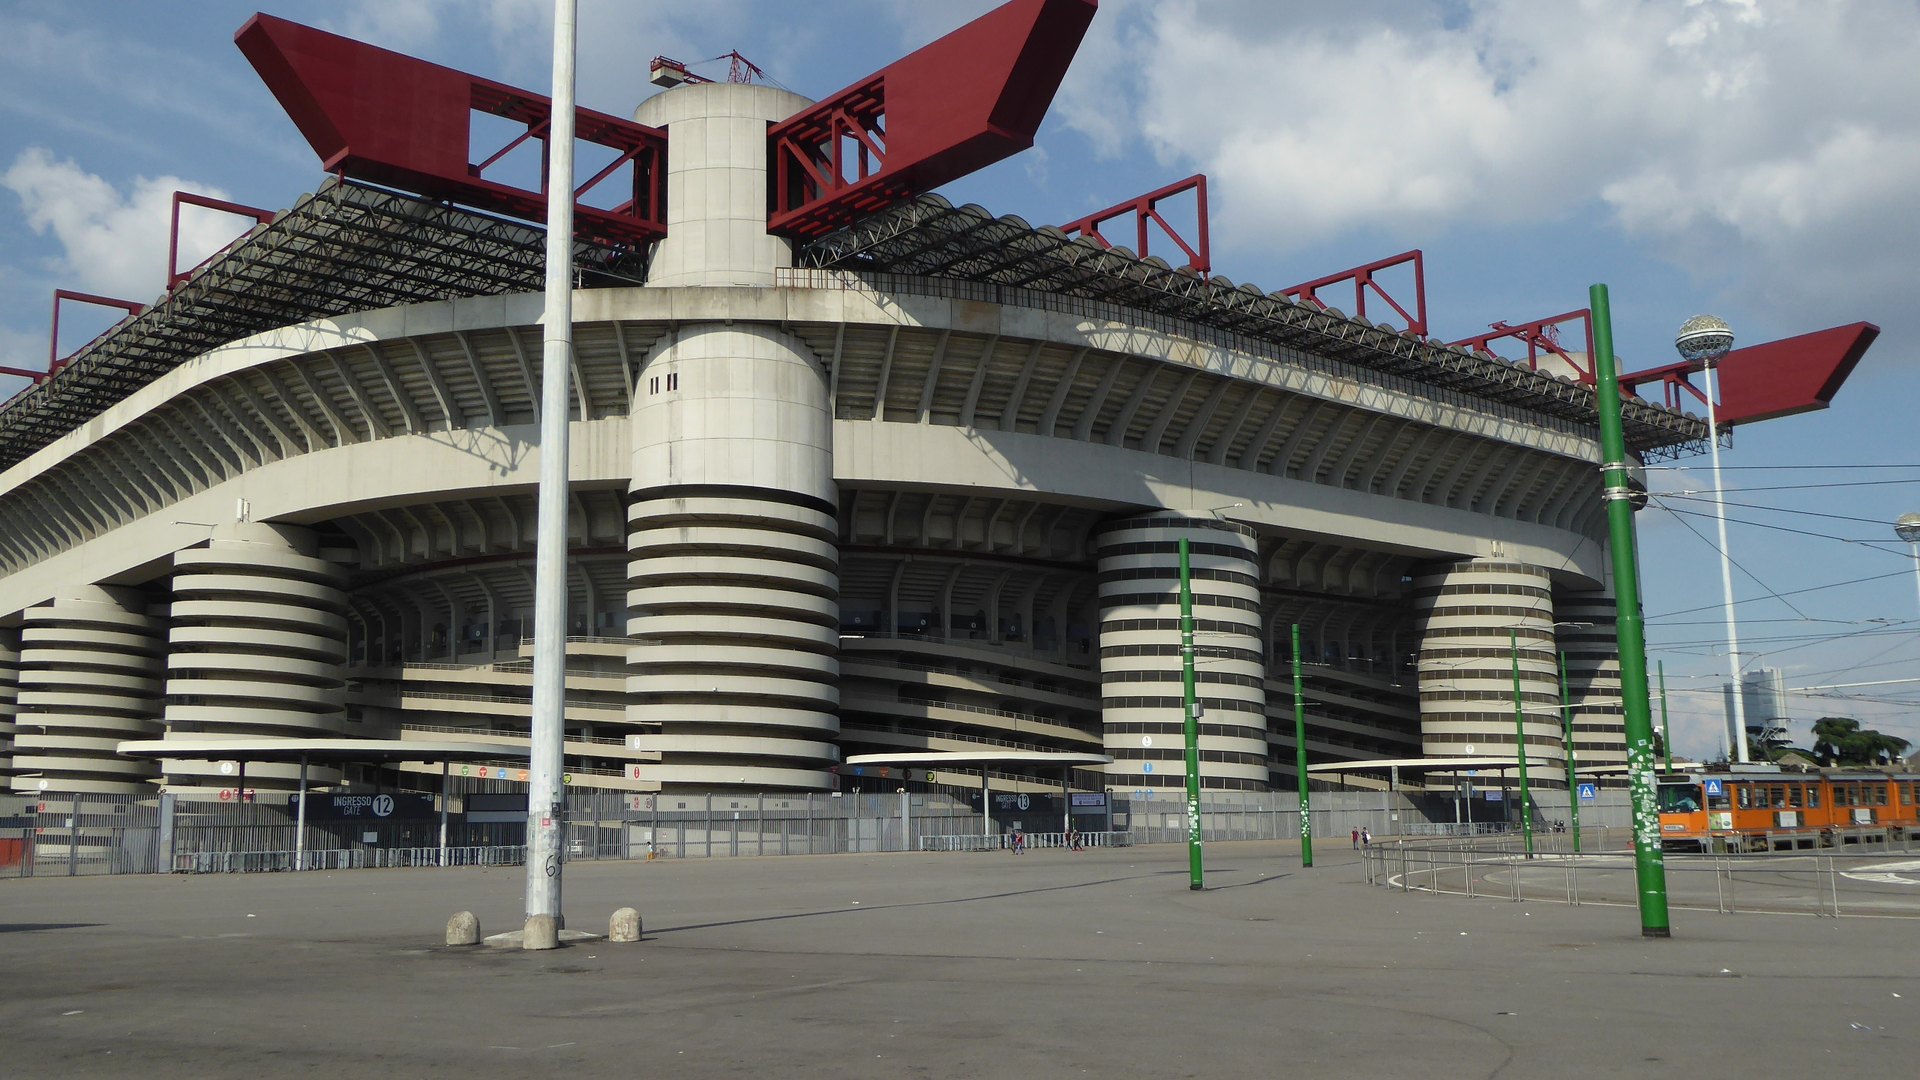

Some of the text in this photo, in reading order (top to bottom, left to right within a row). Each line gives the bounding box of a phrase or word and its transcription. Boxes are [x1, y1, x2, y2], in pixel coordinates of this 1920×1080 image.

[333, 796, 372, 806] INGRESSO
[375, 797, 391, 814] 12
[1019, 795, 1029, 809] 13
[343, 805, 361, 815] GATE
